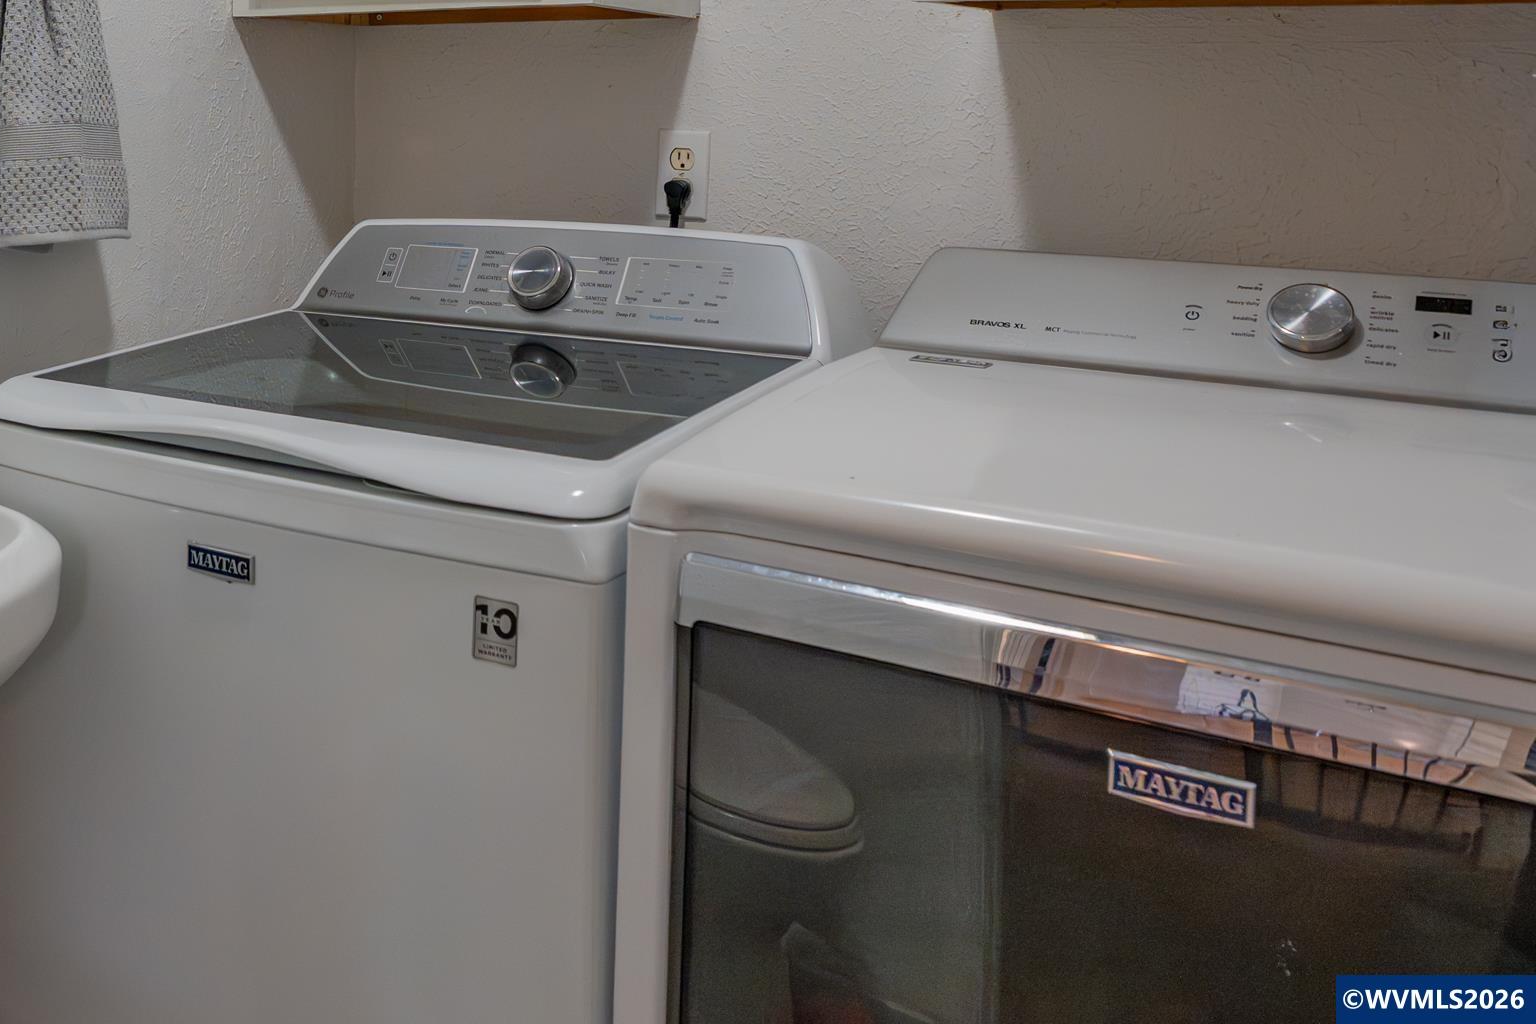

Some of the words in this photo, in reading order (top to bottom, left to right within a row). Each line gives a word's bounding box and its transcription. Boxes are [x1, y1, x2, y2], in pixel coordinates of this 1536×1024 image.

[329, 289, 356, 300] Profile
[969, 319, 1011, 329] BRAVOS
[1013, 322, 1027, 330] XL
[189, 548, 249, 578] MAYTAG
[1117, 766, 1245, 815] MAYTAG
